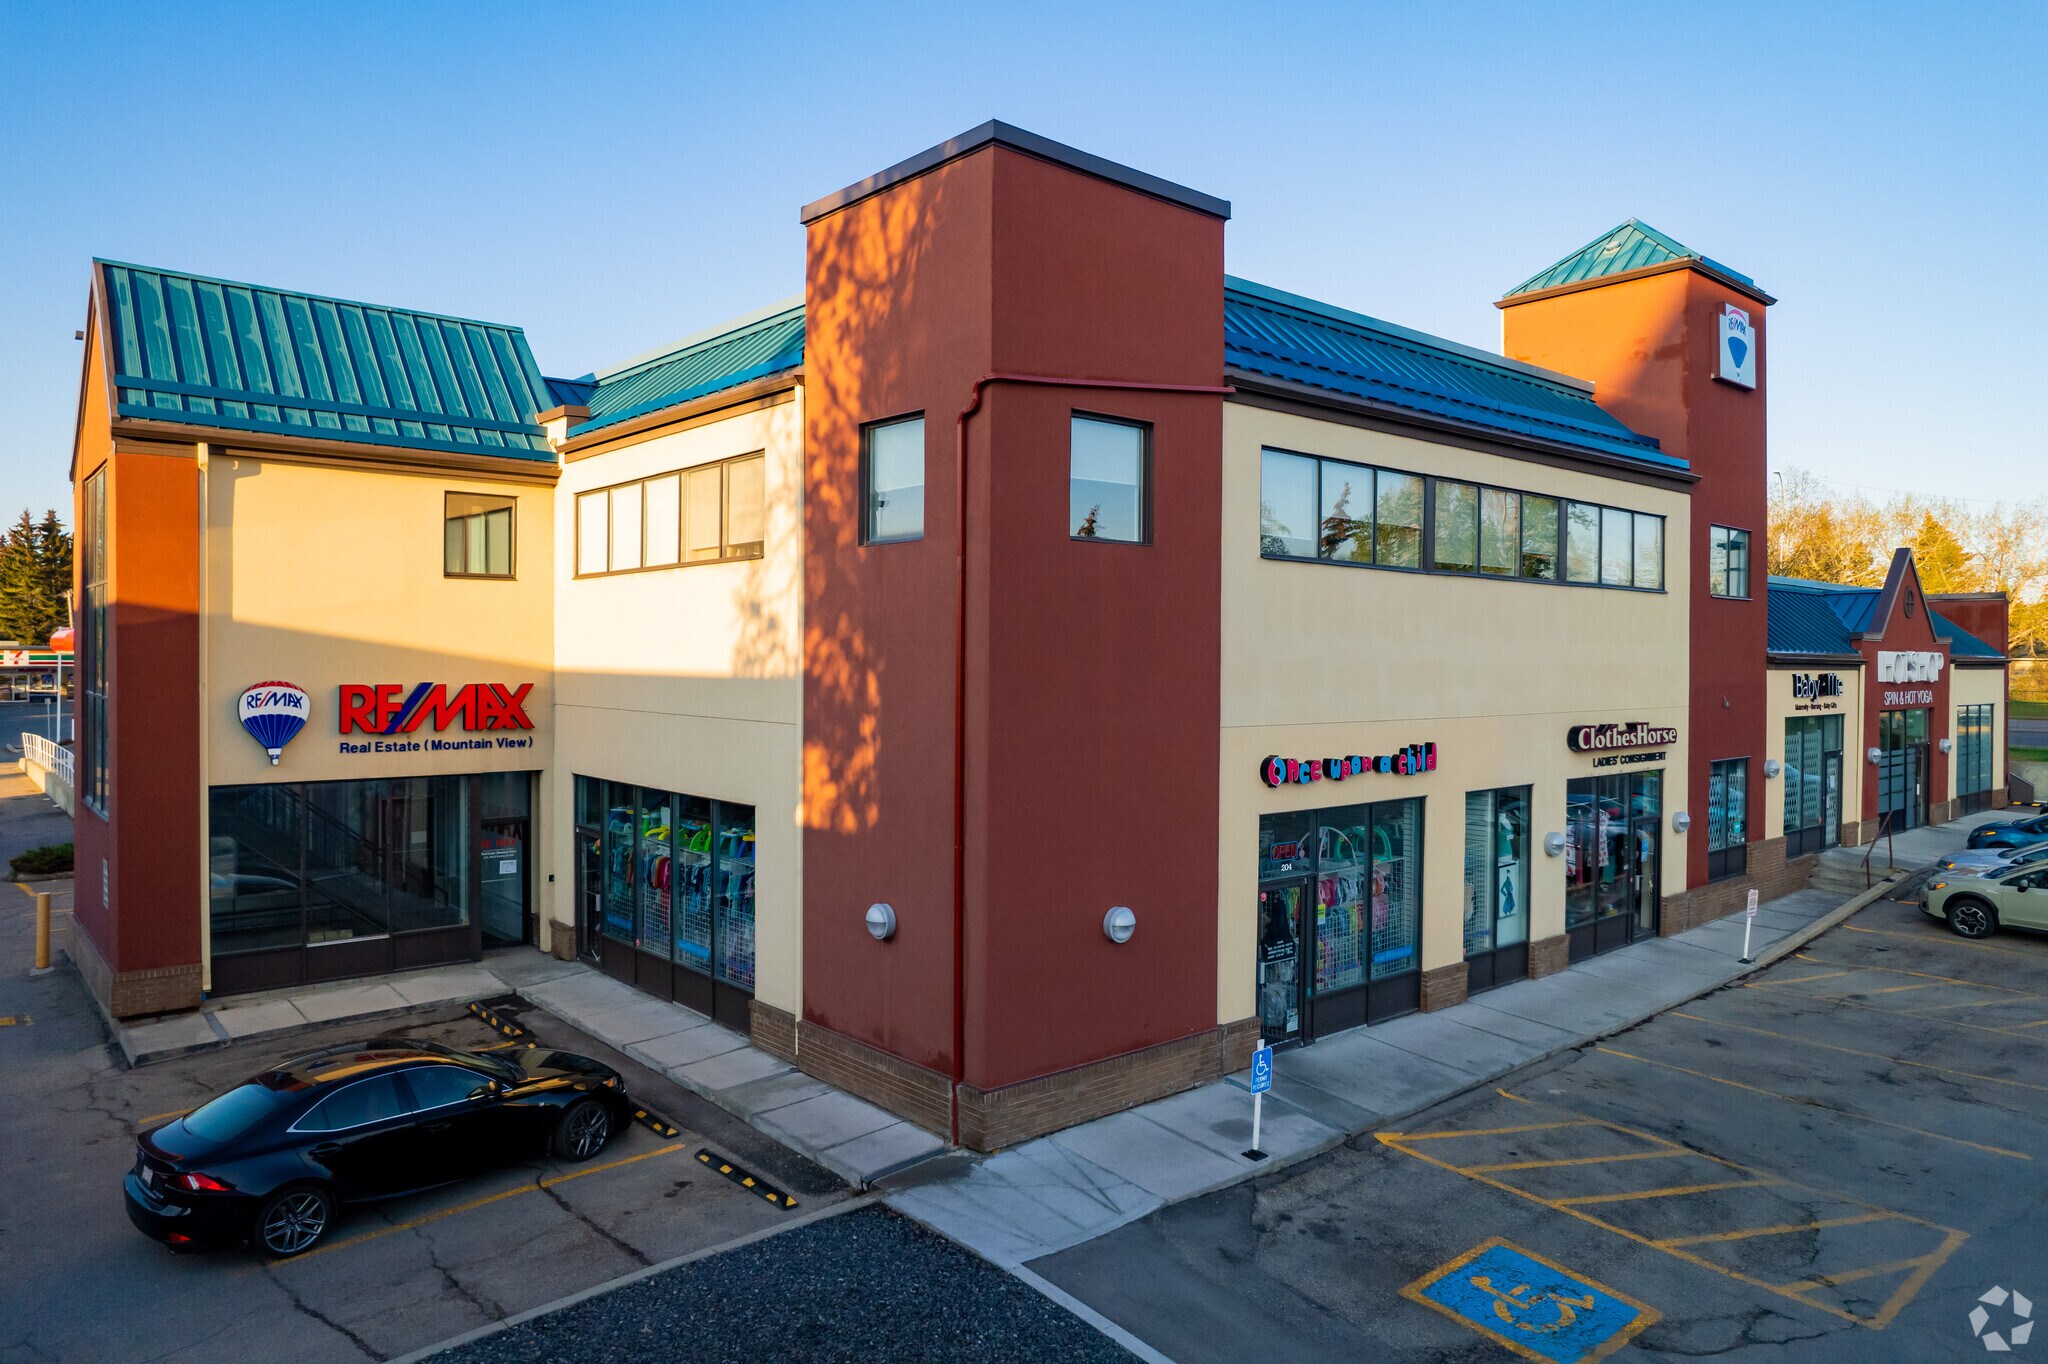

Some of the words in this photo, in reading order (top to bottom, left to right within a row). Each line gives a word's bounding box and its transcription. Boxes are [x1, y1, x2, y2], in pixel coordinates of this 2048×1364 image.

[1792, 673, 1821, 702] Baby
[1827, 673, 1843, 696] Me
[247, 690, 303, 710] RE/MAX
[1884, 691, 1899, 706] SPIN
[1899, 692, 1905, 704] &
[1905, 690, 1917, 704] HOT
[1916, 690, 1933, 704] YOGA
[339, 682, 535, 735] RE/MAX
[339, 742, 371, 753] Real
[374, 740, 420, 752] Estate
[1261, 755, 1323, 787] Once
[1323, 755, 1373, 781] upon
[1374, 756, 1392, 774] a
[1393, 742, 1437, 776] child
[1271, 844, 1298, 860] OPEN
[1281, 863, 1293, 872] 204
